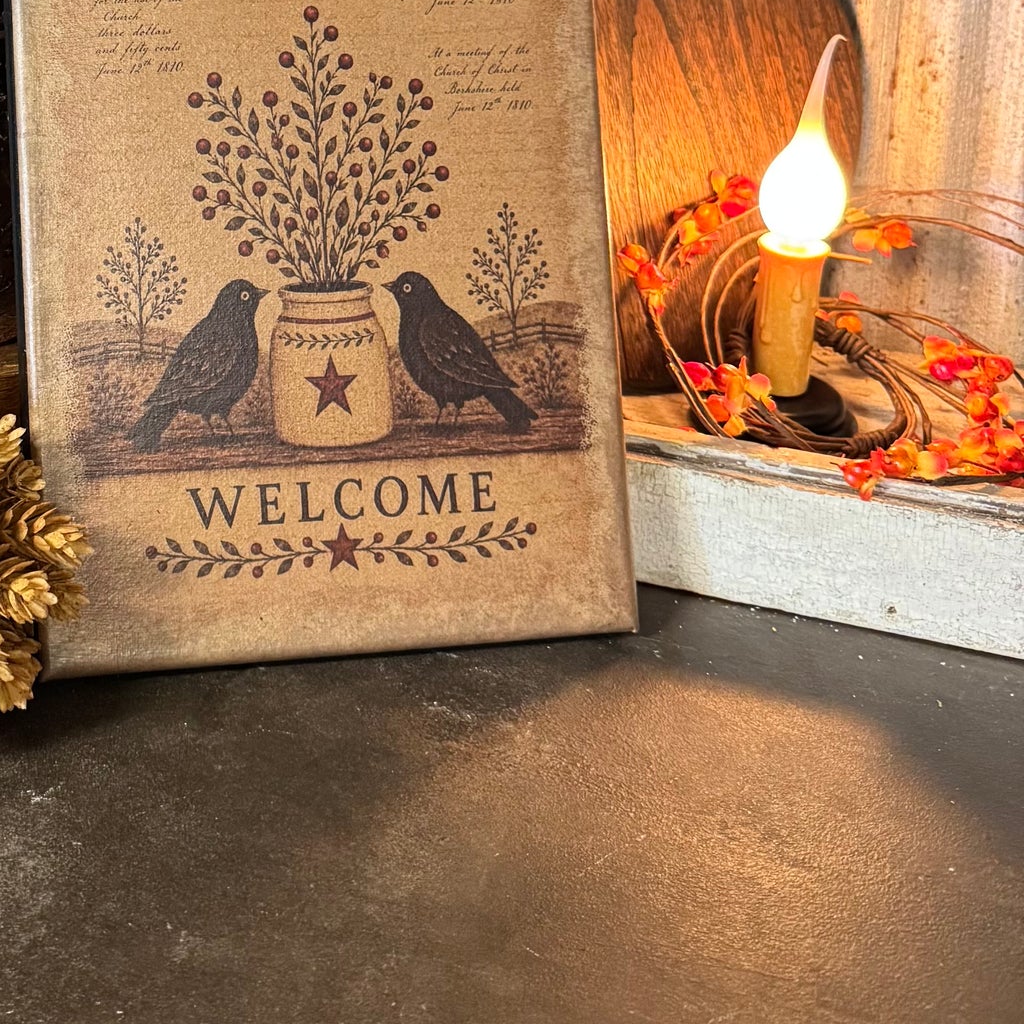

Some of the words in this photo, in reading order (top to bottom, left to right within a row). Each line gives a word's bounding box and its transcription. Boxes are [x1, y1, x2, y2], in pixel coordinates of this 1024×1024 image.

[103, 8, 142, 22] Church
[97, 26, 125, 38] three
[132, 23, 172, 37] dollars
[96, 42, 119, 55] and
[119, 41, 149, 61] fifty
[154, 40, 182, 53] cents
[457, 44, 496, 63] meeting
[499, 44, 512, 62] of
[515, 42, 530, 55] the
[94, 62, 123, 81] June
[433, 63, 468, 77] Church
[471, 63, 484, 85] of
[487, 62, 518, 75] Christ
[444, 80, 494, 95] Berkshire
[499, 79, 522, 92] held
[447, 100, 476, 121] June
[186, 470, 496, 530] WELCOME
